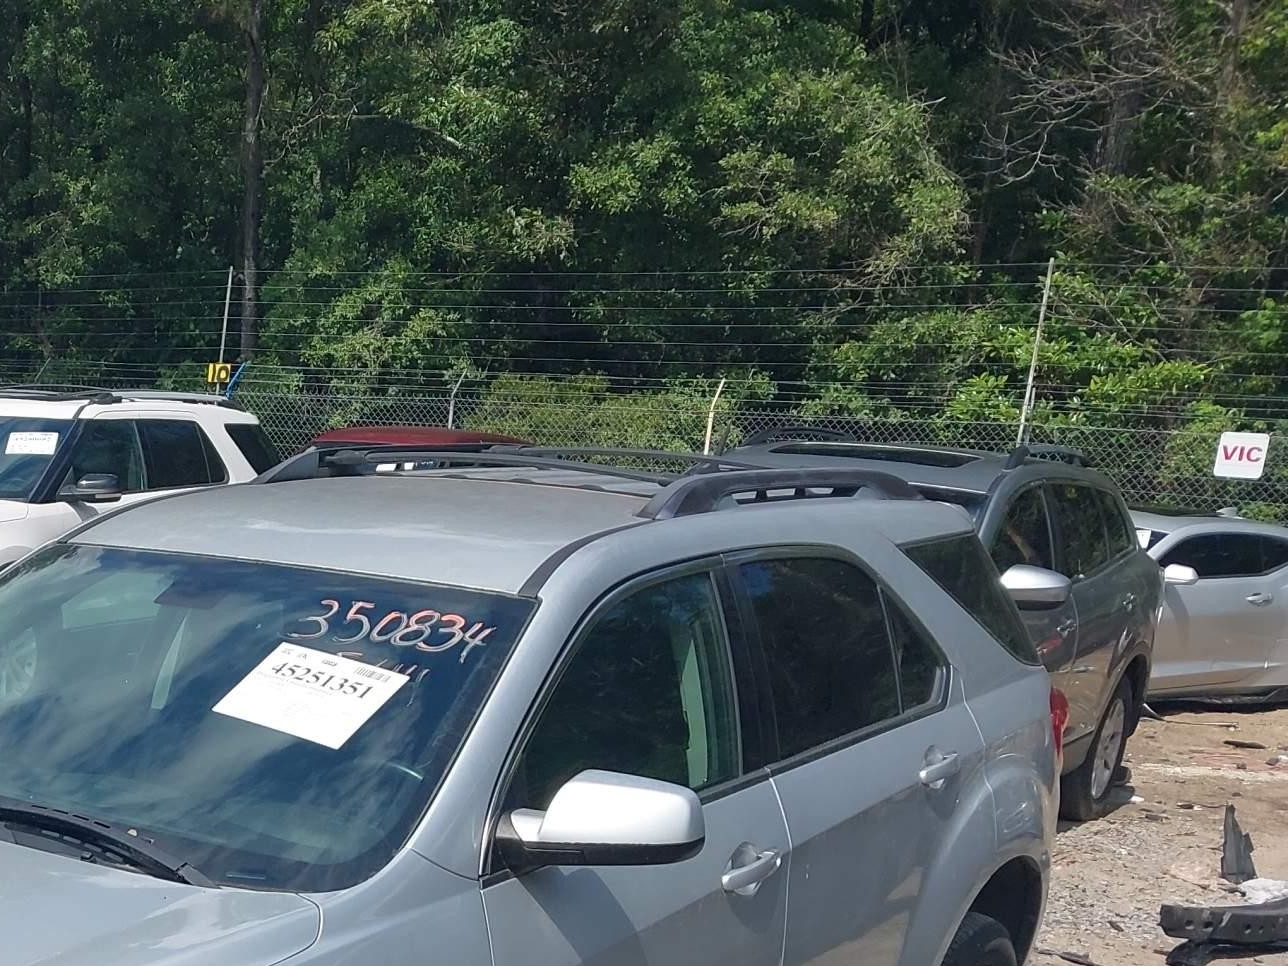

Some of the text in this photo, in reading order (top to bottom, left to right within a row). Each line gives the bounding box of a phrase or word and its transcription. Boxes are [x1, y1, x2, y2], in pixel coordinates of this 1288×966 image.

[210, 363, 230, 382] 10
[1222, 445, 1264, 463] VIC
[284, 599, 497, 664] 350834
[271, 661, 375, 700] 45251351
